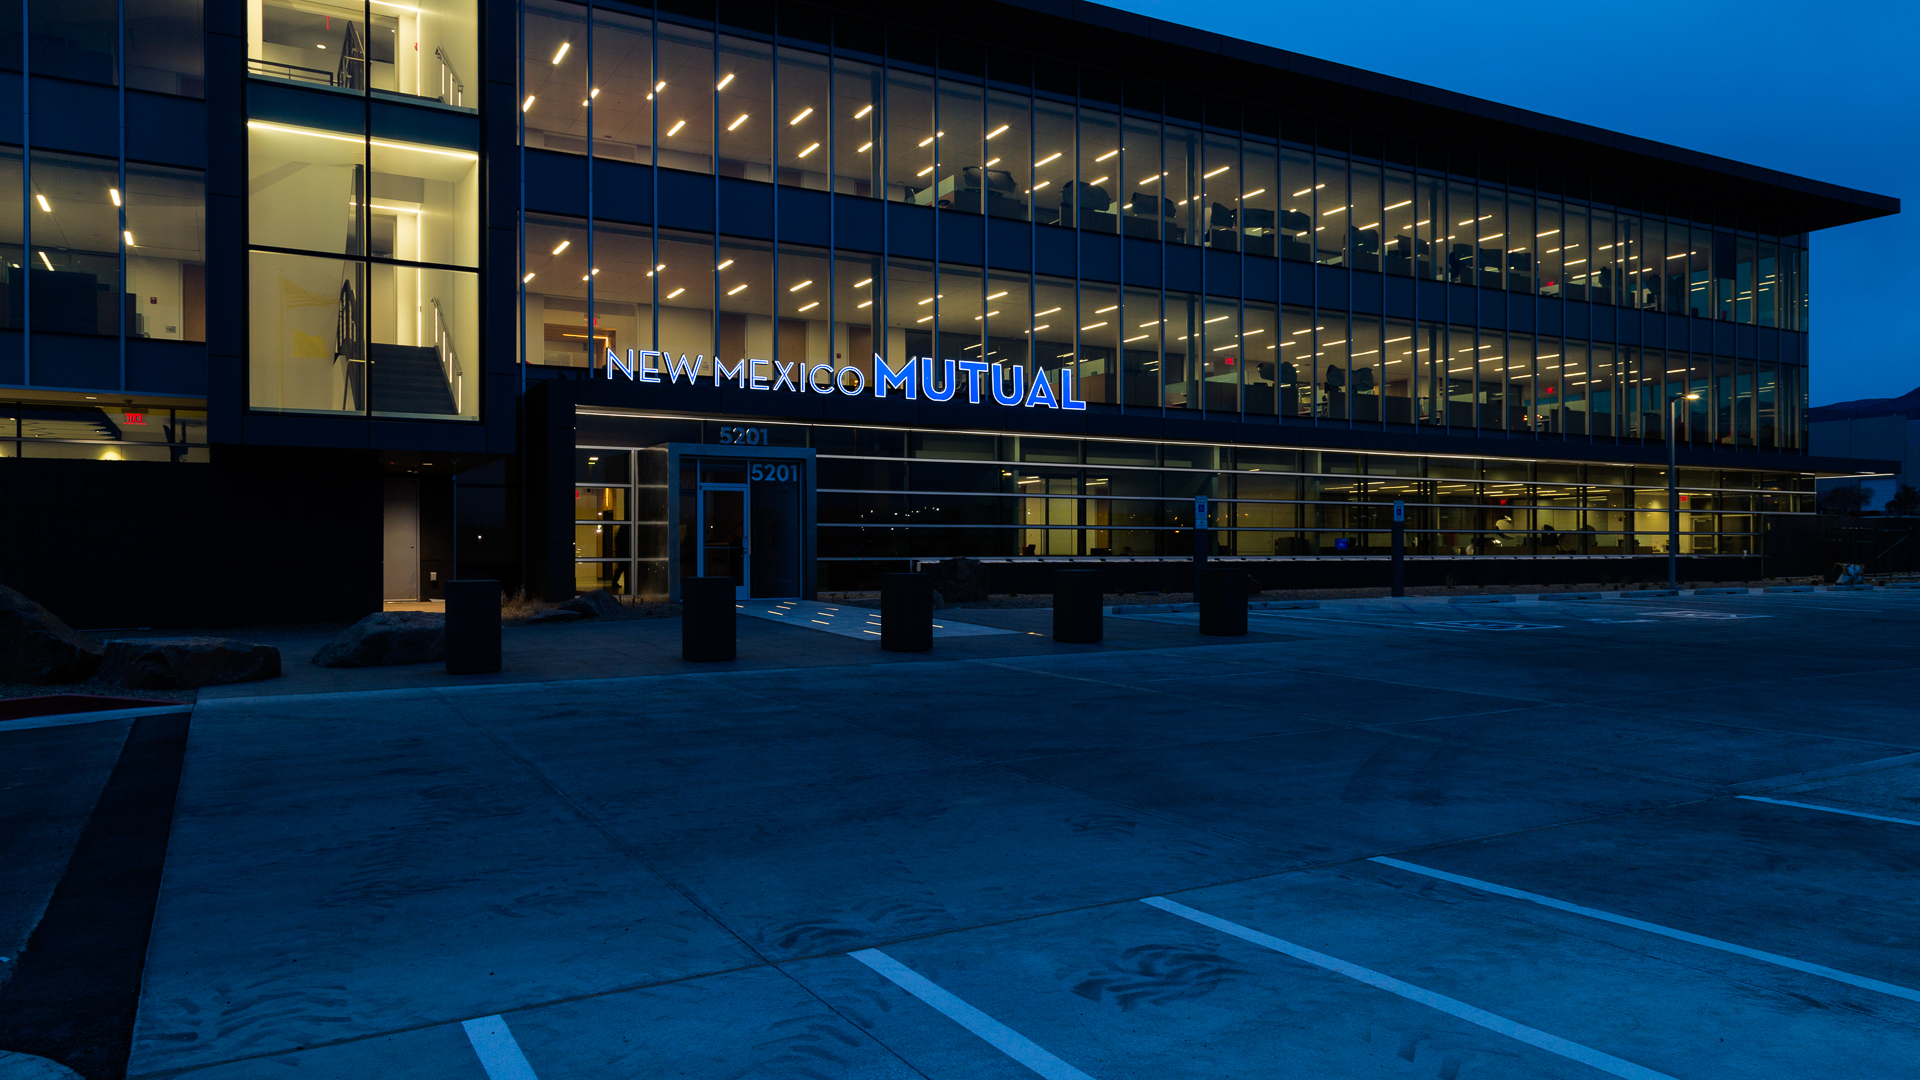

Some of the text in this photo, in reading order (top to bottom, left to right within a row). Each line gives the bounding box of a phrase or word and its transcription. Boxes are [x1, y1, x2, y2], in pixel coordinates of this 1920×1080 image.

[606, 348, 1087, 411] NEW MEXICO MUTUAL
[719, 426, 768, 446] 5201
[750, 463, 798, 482] 5201
